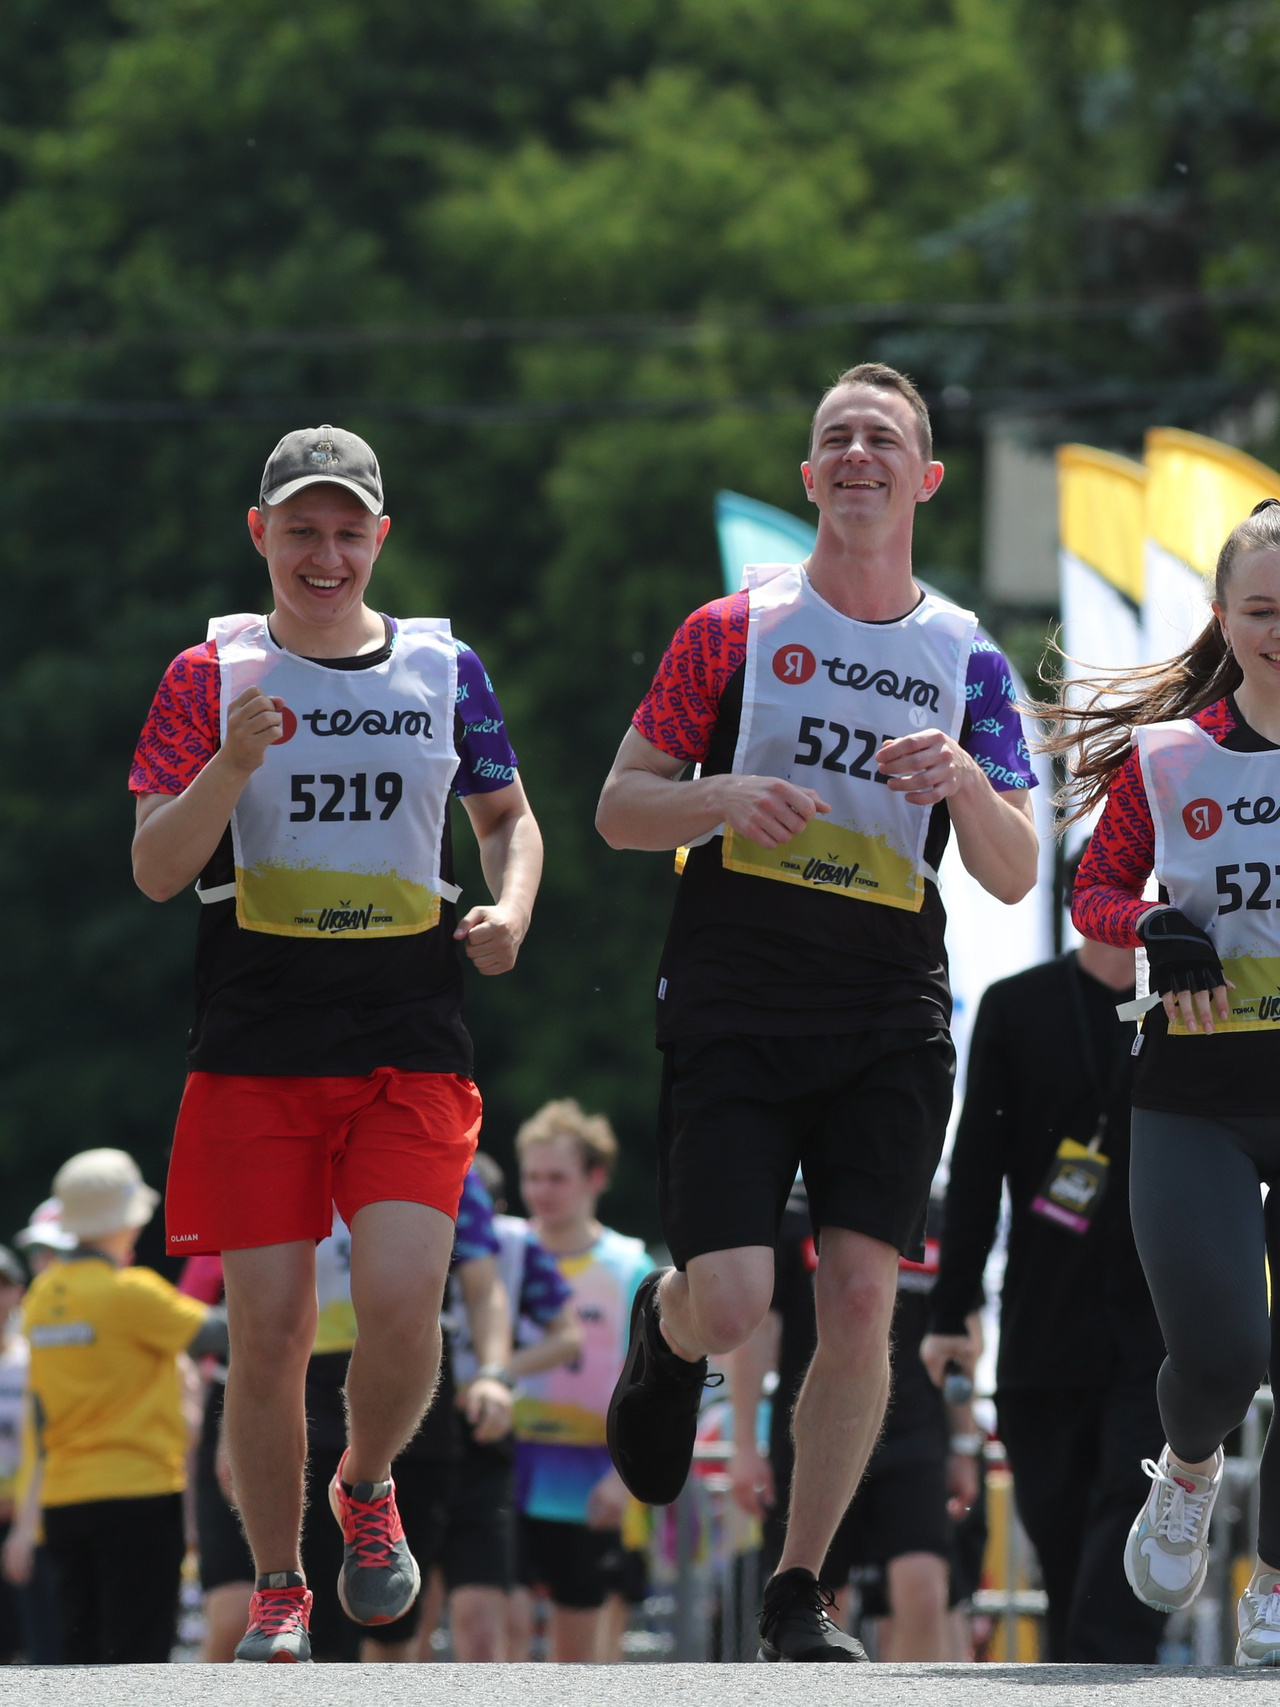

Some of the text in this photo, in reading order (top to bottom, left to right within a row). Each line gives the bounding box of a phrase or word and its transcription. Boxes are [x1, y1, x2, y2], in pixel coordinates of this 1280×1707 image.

[821, 657, 940, 713] team
[303, 709, 433, 739] team
[290, 772, 402, 822] 5219
[802, 858, 859, 887] URBAN
[318, 904, 373, 934] URBAN
[170, 1233, 199, 1243] OLAIAN
